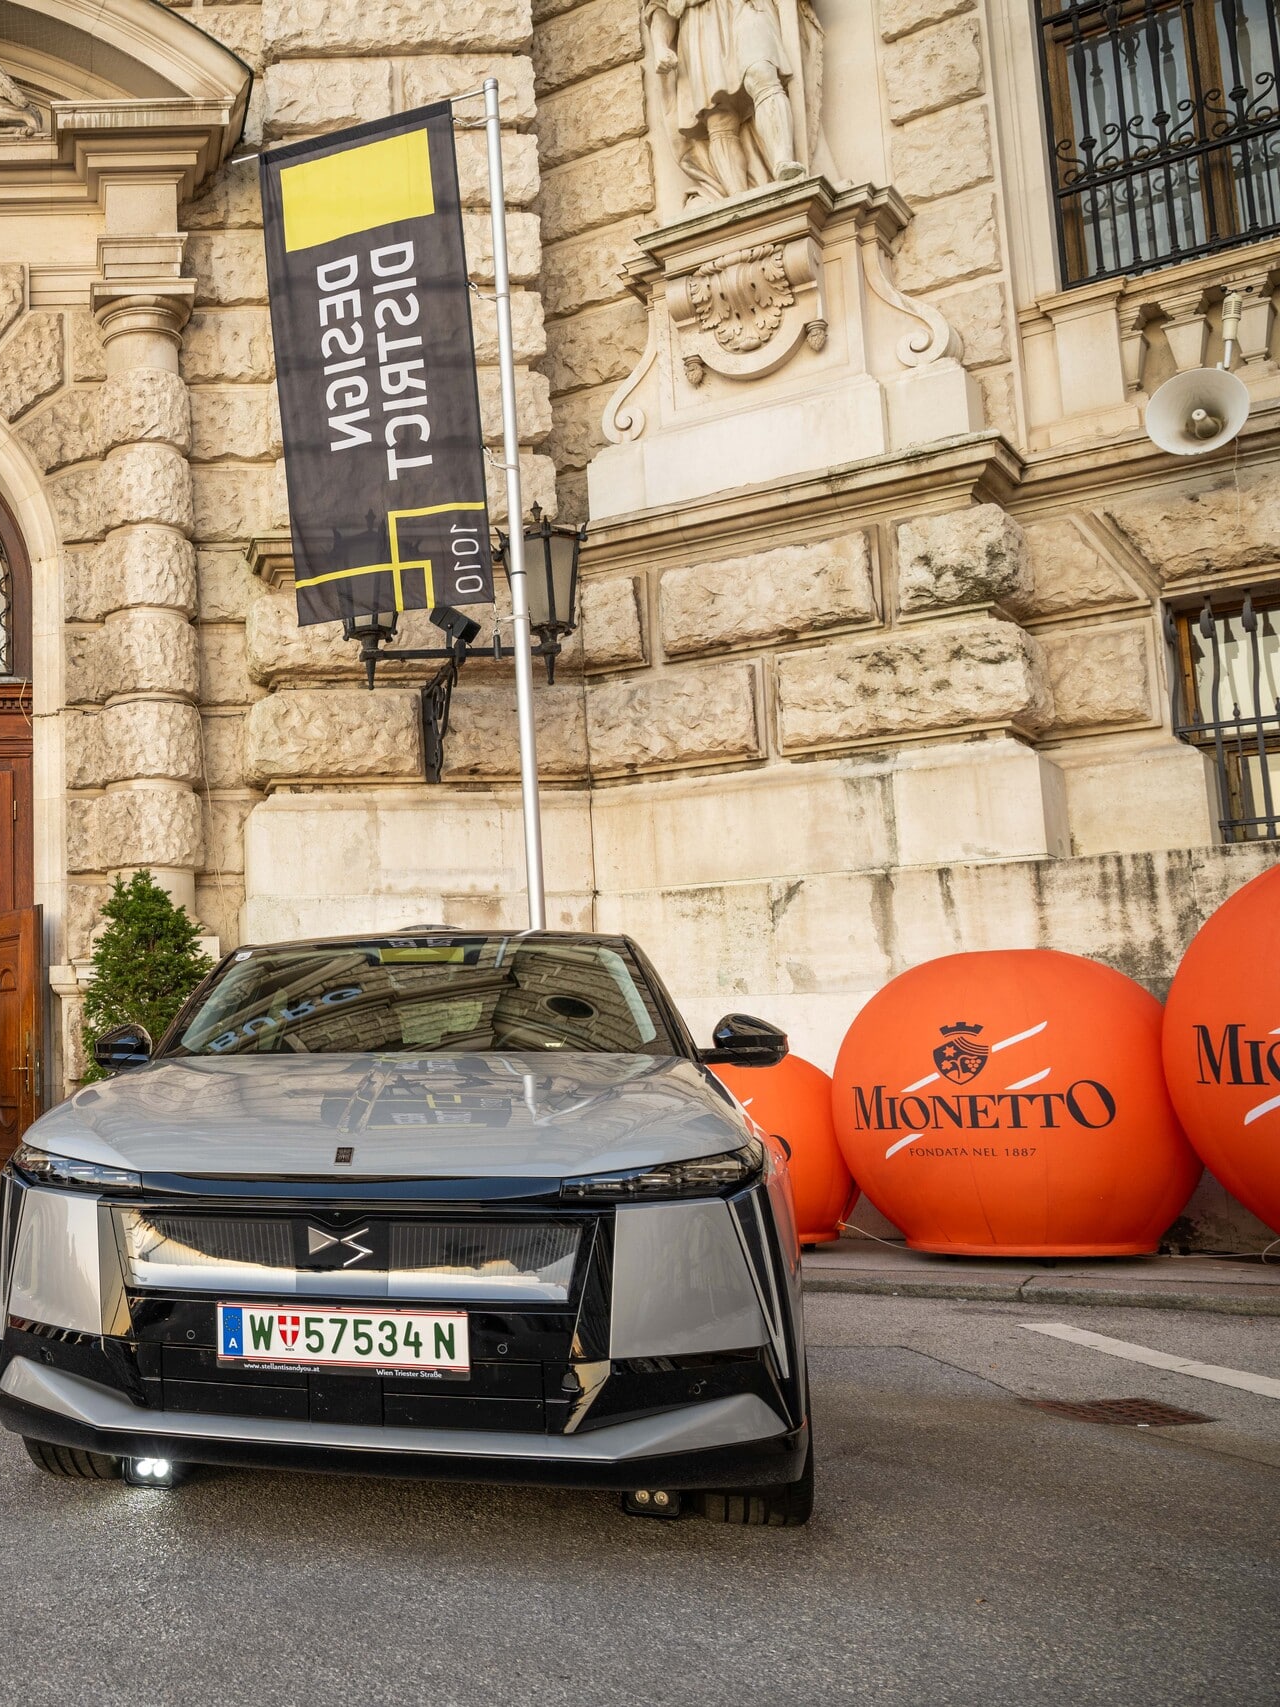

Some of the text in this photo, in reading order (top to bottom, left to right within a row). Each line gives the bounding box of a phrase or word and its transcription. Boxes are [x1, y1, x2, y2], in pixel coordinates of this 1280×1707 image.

[909, 1147, 1037, 1157] FONDATA NEL 1887
[228, 1337, 238, 1348] A
[249, 1314, 274, 1351] W
[243, 1363, 320, 1373] www.stellantisandyou.at
[376, 1368, 443, 1379] Wien Triester Straße
